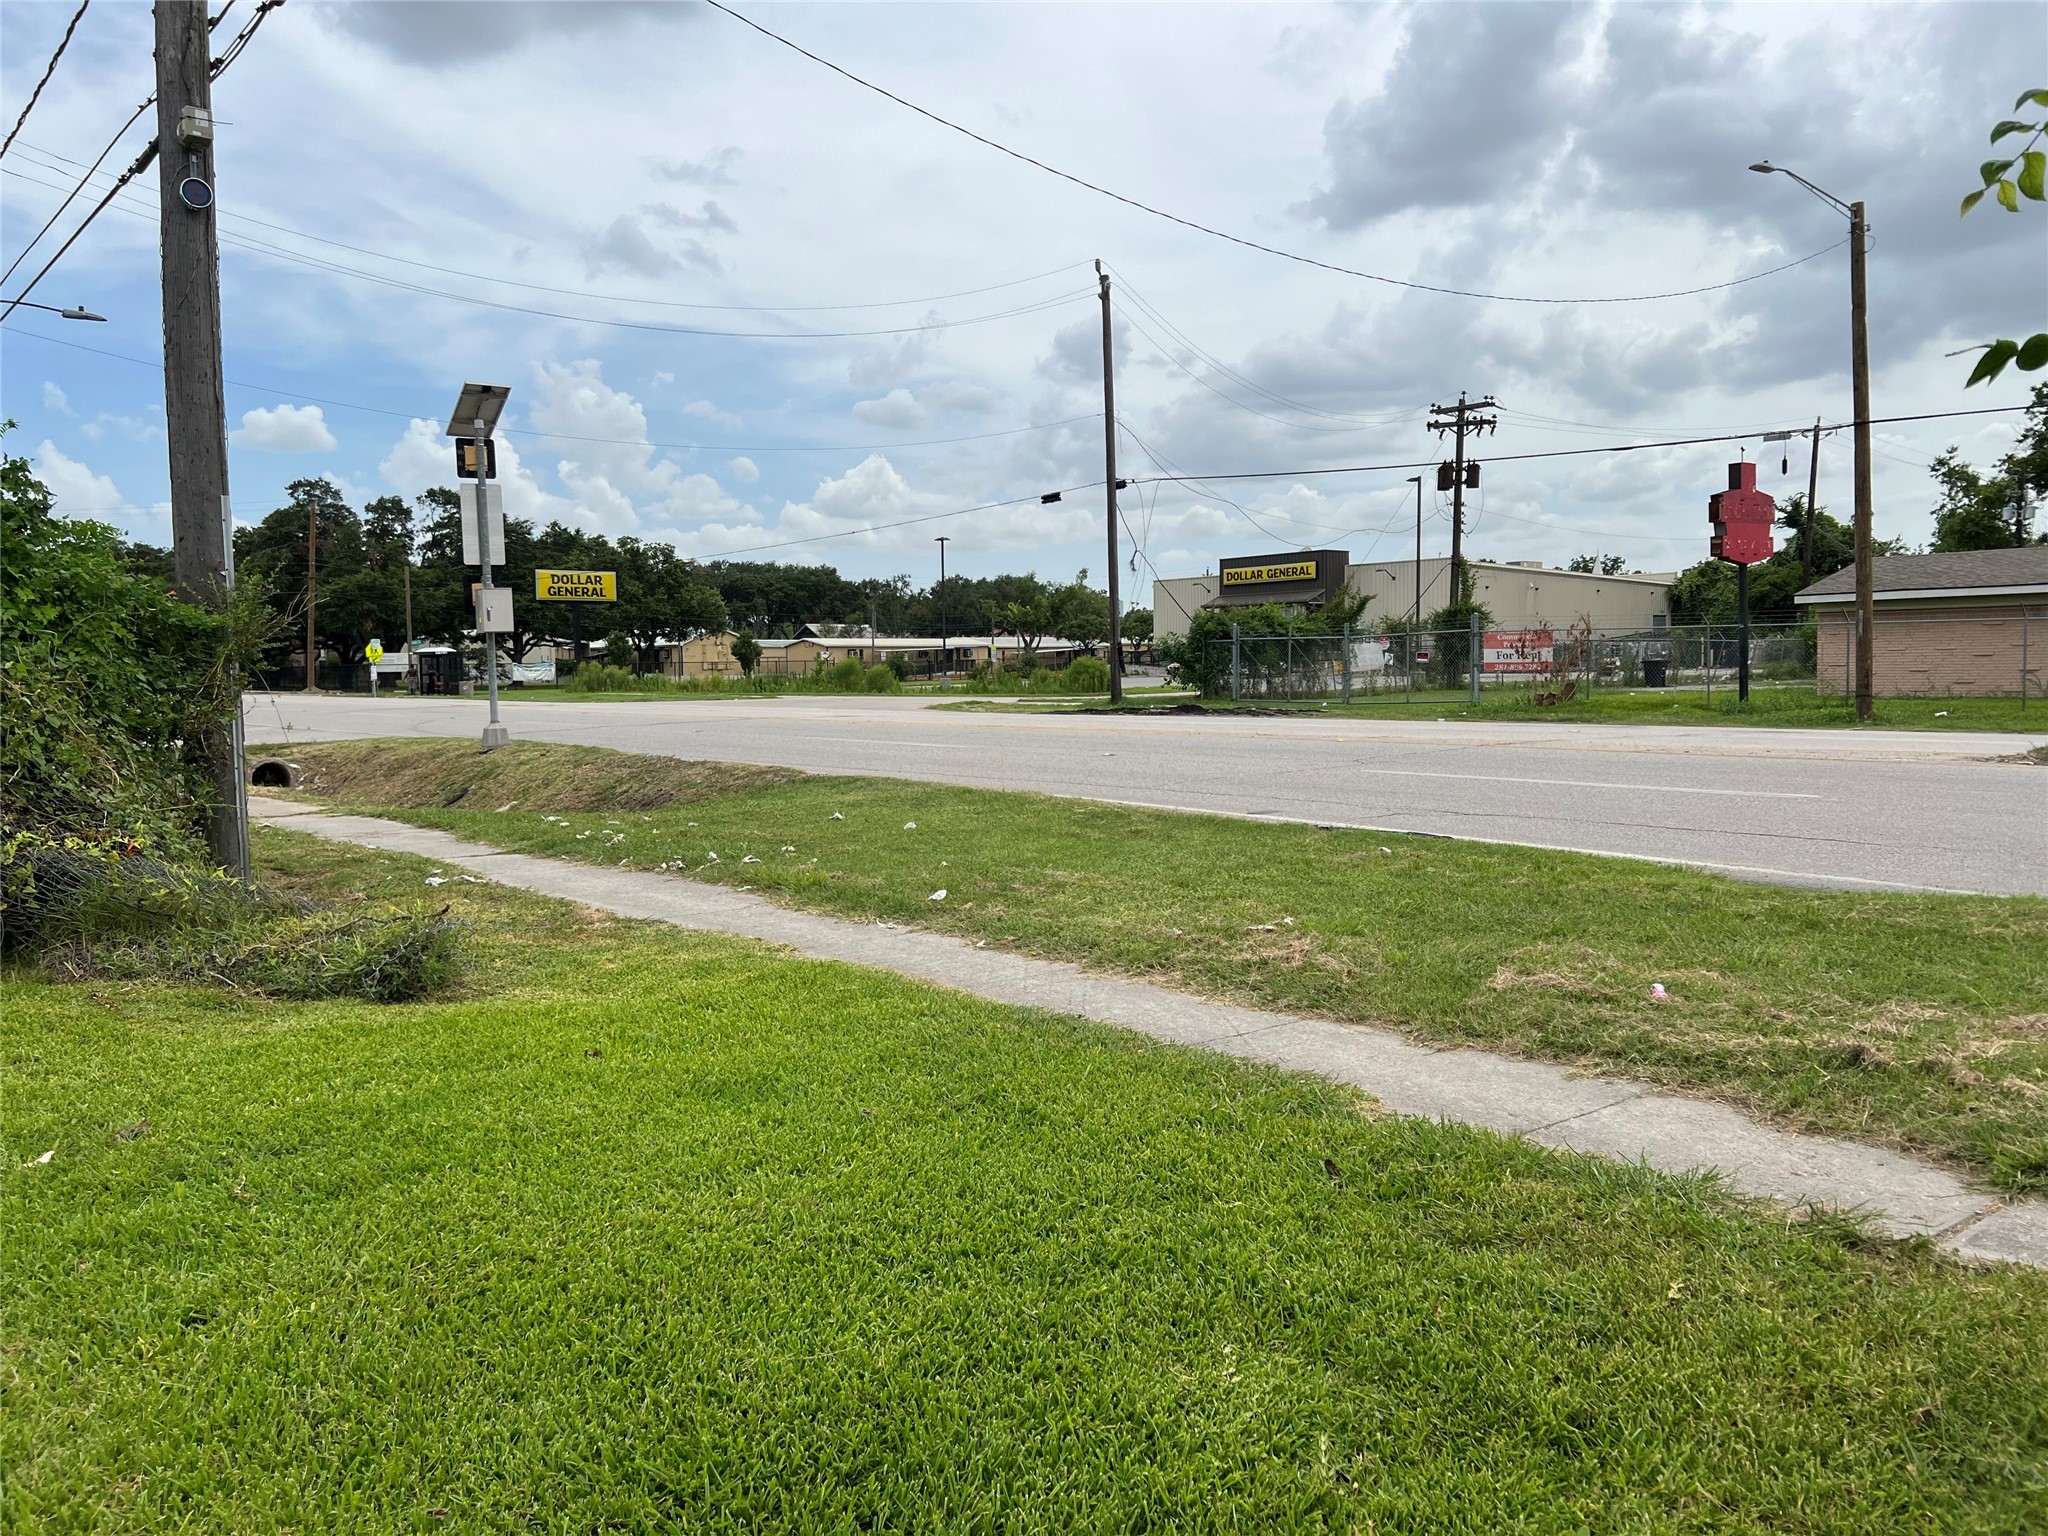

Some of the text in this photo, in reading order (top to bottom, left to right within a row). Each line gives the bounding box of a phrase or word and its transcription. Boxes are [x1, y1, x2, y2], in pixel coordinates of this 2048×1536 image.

[1226, 566, 1311, 581] DOLLAR GENERAL
[551, 574, 603, 585] DOLLAR
[547, 586, 606, 597] GENERAL
[1496, 650, 1514, 660] For
